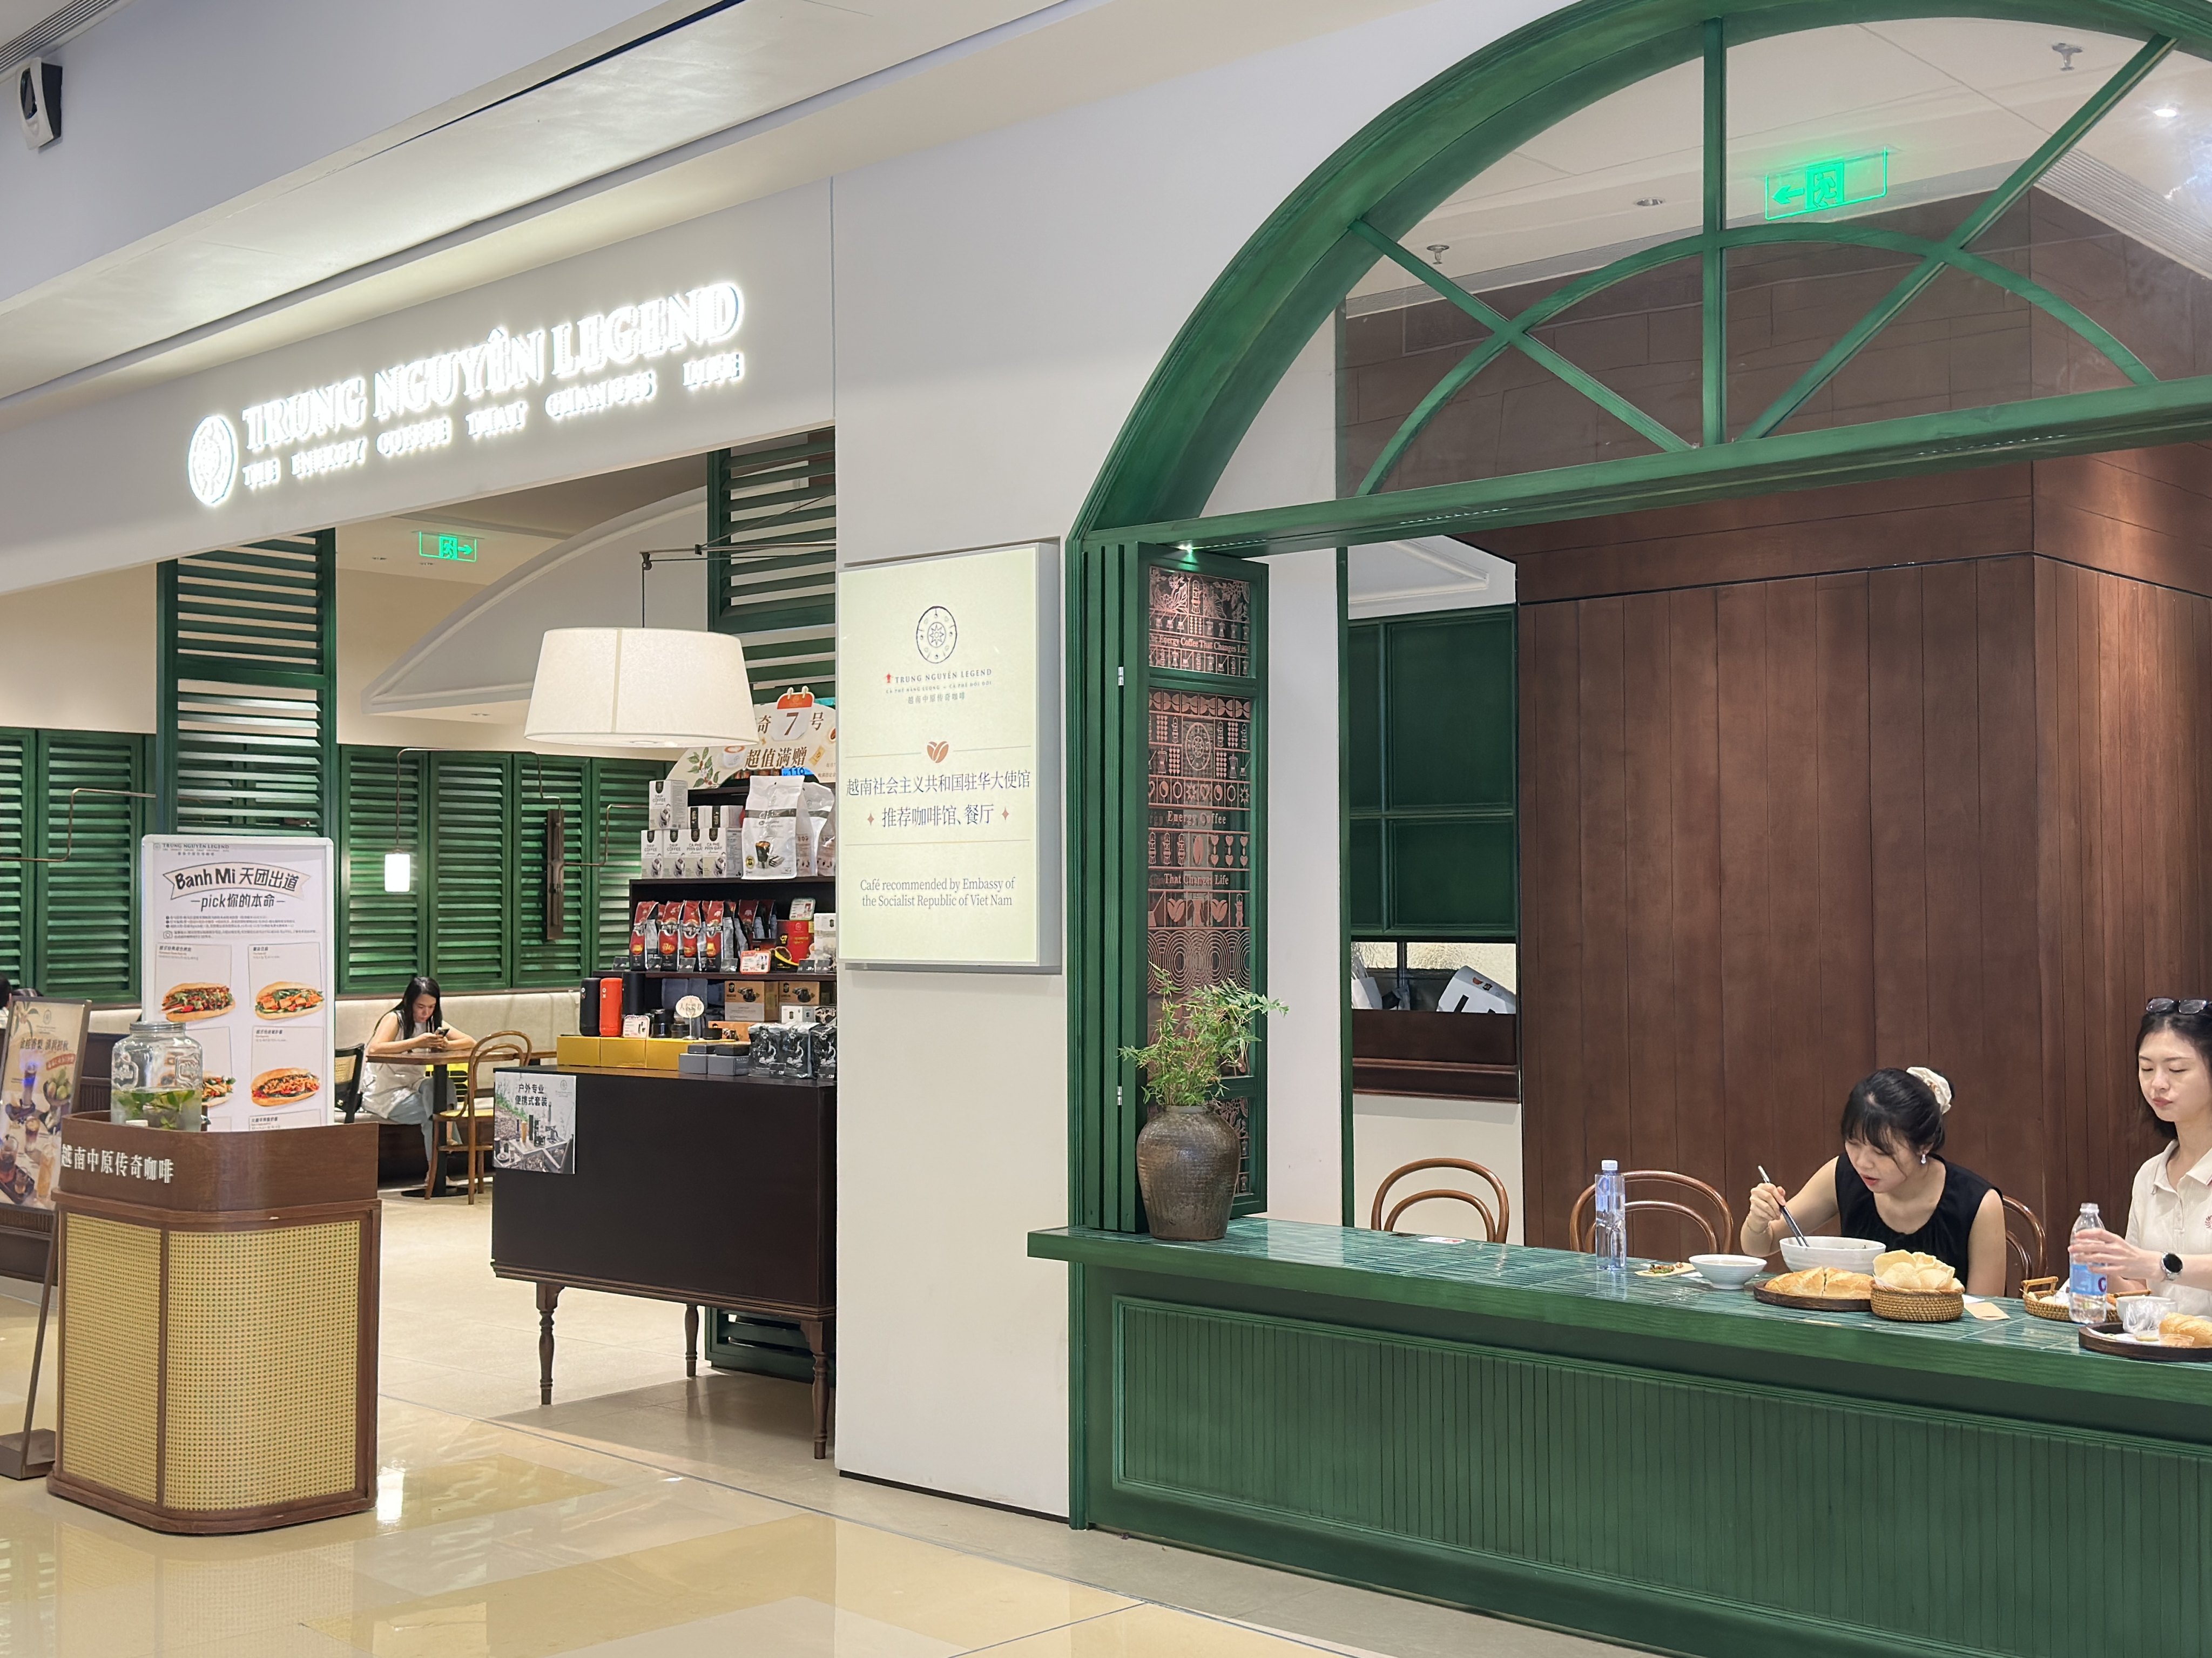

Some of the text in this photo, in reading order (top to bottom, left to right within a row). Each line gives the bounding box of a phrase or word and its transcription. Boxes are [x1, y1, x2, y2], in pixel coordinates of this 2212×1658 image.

[241, 283, 742, 451] TRUNG NGUYÊN LEGEND
[1159, 636, 1180, 646] Energy
[1181, 637, 1199, 648] Coffee
[1199, 640, 1213, 649] That
[1214, 642, 1236, 652] Changes
[895, 675, 922, 684] TRUNG
[961, 669, 992, 678] LEGEND
[908, 692, 965, 704] 越南中原传奇咖啡
[744, 746, 807, 768] 超值满赠
[846, 769, 1030, 796] 越南社会主义共和国驻华大使馆
[881, 804, 995, 827] 推荐咖啡馆、餐厅
[1168, 810, 1226, 825] Energy Coffee
[174, 867, 299, 892] Banh Mi 天团出道
[860, 877, 1015, 893] Café recommended by Embassy of
[1164, 873, 1182, 885] That
[1214, 874, 1229, 885] Life
[862, 893, 1013, 909] the Socialist Republic of Viet Nam
[518, 1083, 544, 1094] 户外专业
[515, 1095, 548, 1107] 便携式套装
[60, 1143, 174, 1184] 越南中原传奇咖啡
